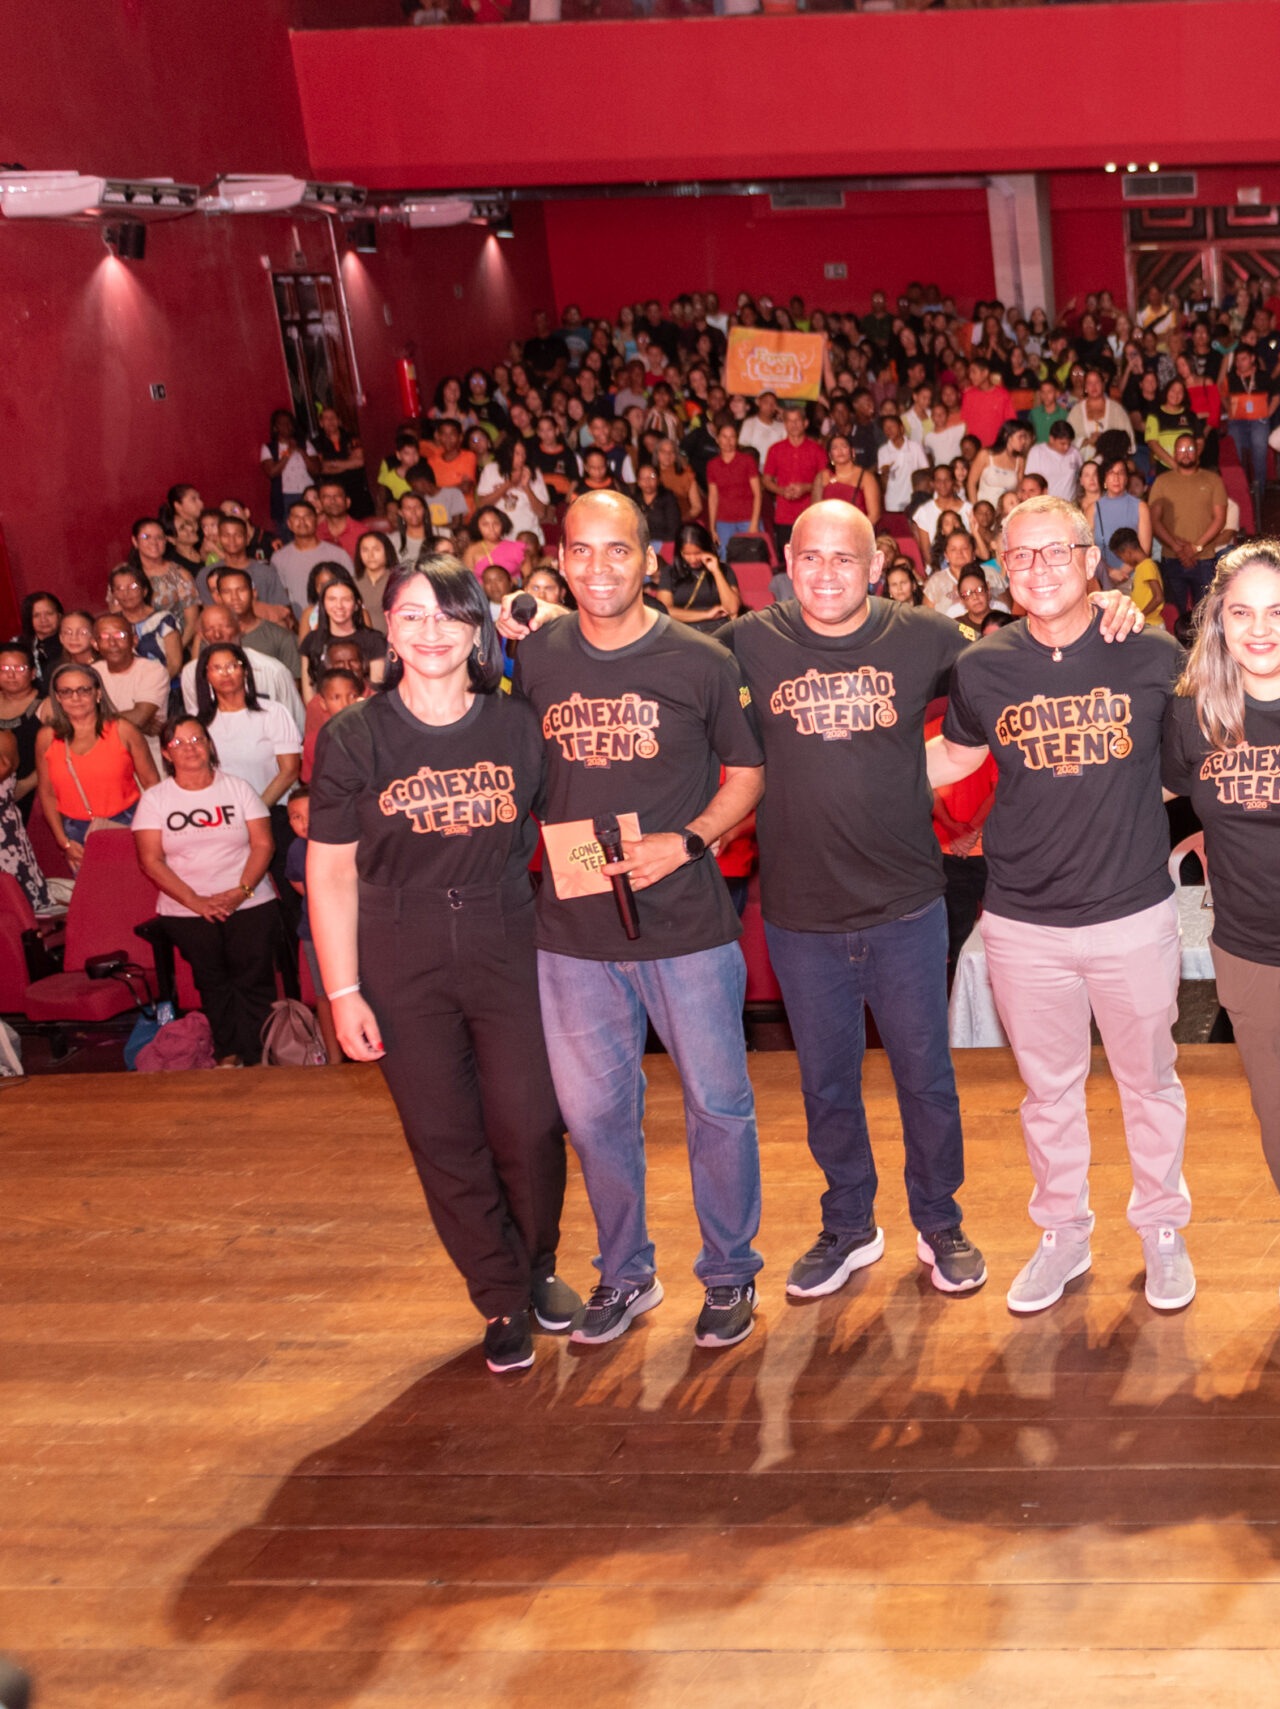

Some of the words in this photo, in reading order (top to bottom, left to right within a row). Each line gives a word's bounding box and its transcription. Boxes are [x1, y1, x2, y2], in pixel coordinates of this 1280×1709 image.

[782, 669, 890, 707] CONEXÃO
[550, 697, 654, 732] CONEXÃO
[794, 703, 871, 731] TEEN
[1005, 692, 1126, 738] CONEXÃO
[559, 731, 631, 758] TEEN
[826, 730, 848, 738] 2026
[586, 758, 608, 767] 2026
[1020, 733, 1105, 767] TEEN
[1056, 765, 1079, 775] 2026
[391, 764, 510, 807] CONEXÃO
[166, 805, 235, 831] OQJF
[409, 799, 492, 830] TEEN
[1246, 801, 1268, 809] 2026
[444, 826, 468, 836] 2026
